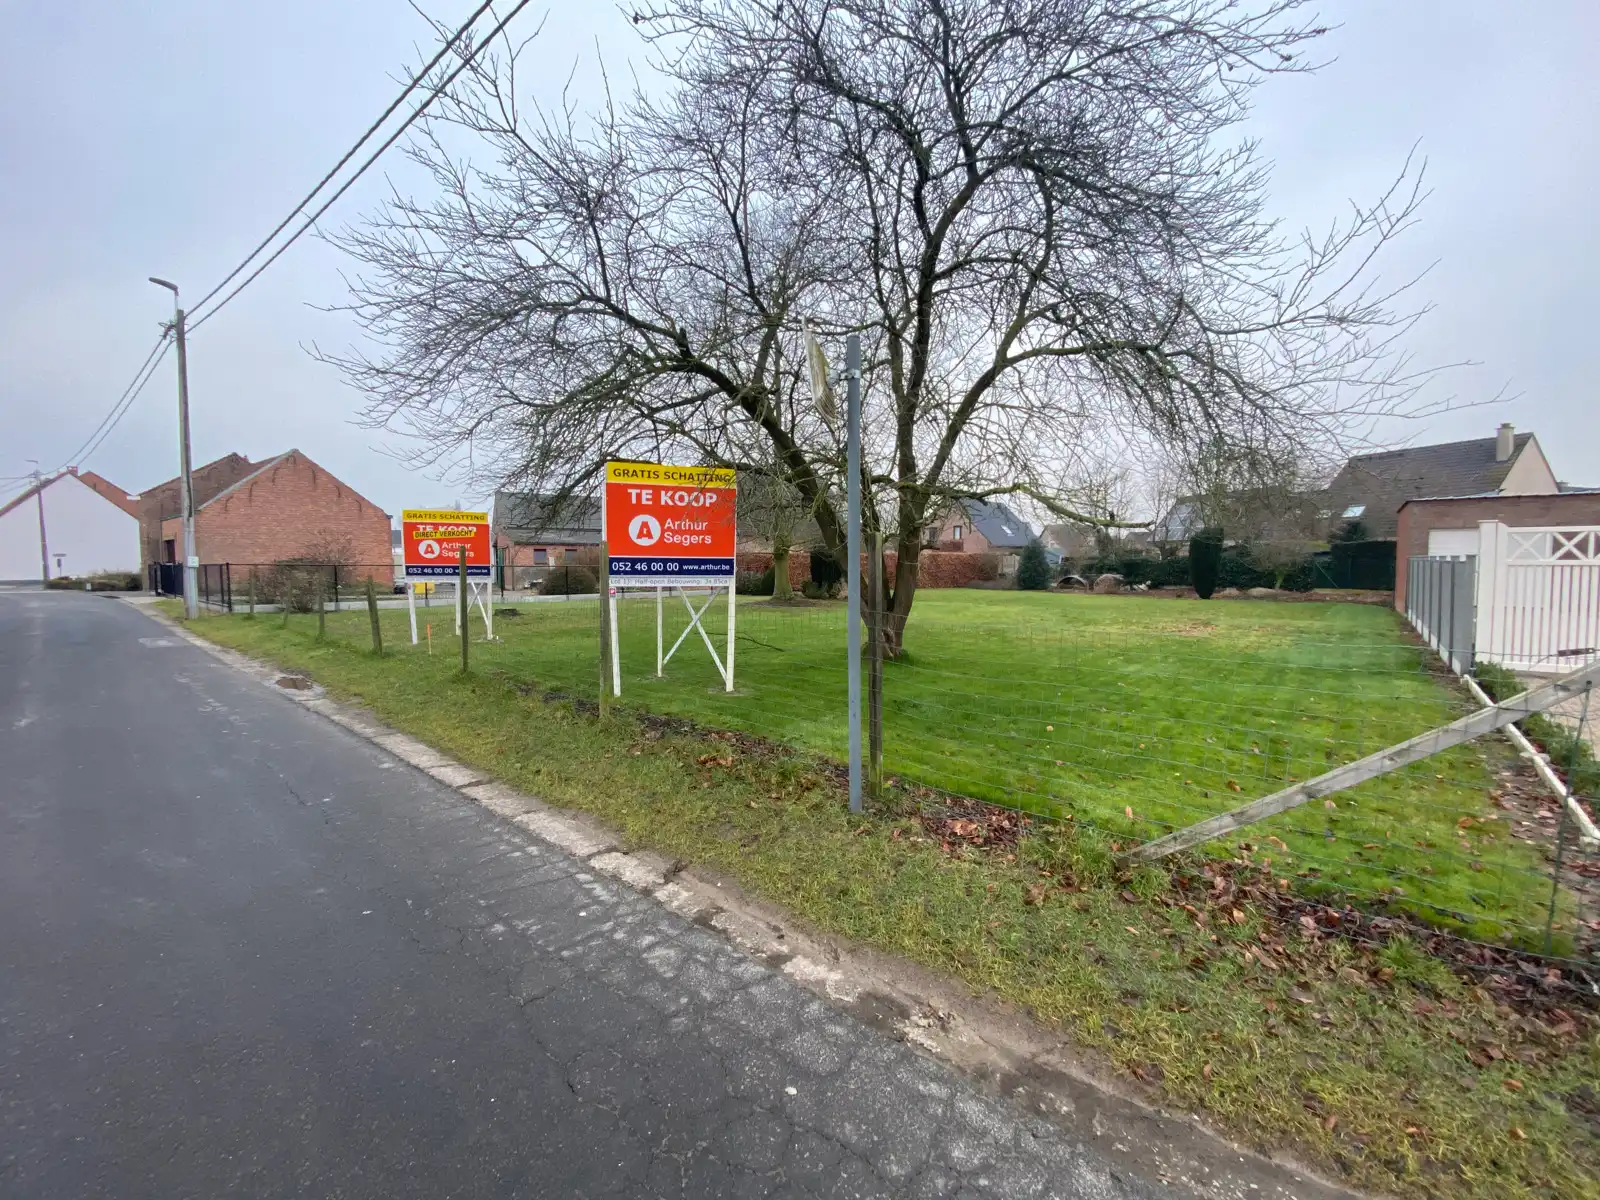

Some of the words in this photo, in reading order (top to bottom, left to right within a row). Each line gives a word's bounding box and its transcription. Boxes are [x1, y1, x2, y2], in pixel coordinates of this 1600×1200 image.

[613, 468, 660, 479] GRATIS
[664, 471, 731, 483] SCHATTING
[627, 488, 653, 505] TE
[660, 490, 718, 507] KOOP
[406, 512, 437, 520] GRATIS
[439, 513, 485, 521] SCHATTING
[664, 518, 708, 531] Arthur
[414, 530, 438, 538] DIRECT
[439, 530, 473, 538] VERKOCHT
[663, 532, 712, 546] Segers
[441, 550, 475, 559] Segrs
[611, 562, 632, 571] 052
[634, 562, 648, 571] 46
[650, 562, 664, 572] 00
[666, 562, 679, 571] 00
[682, 563, 730, 571] www.arthur.be
